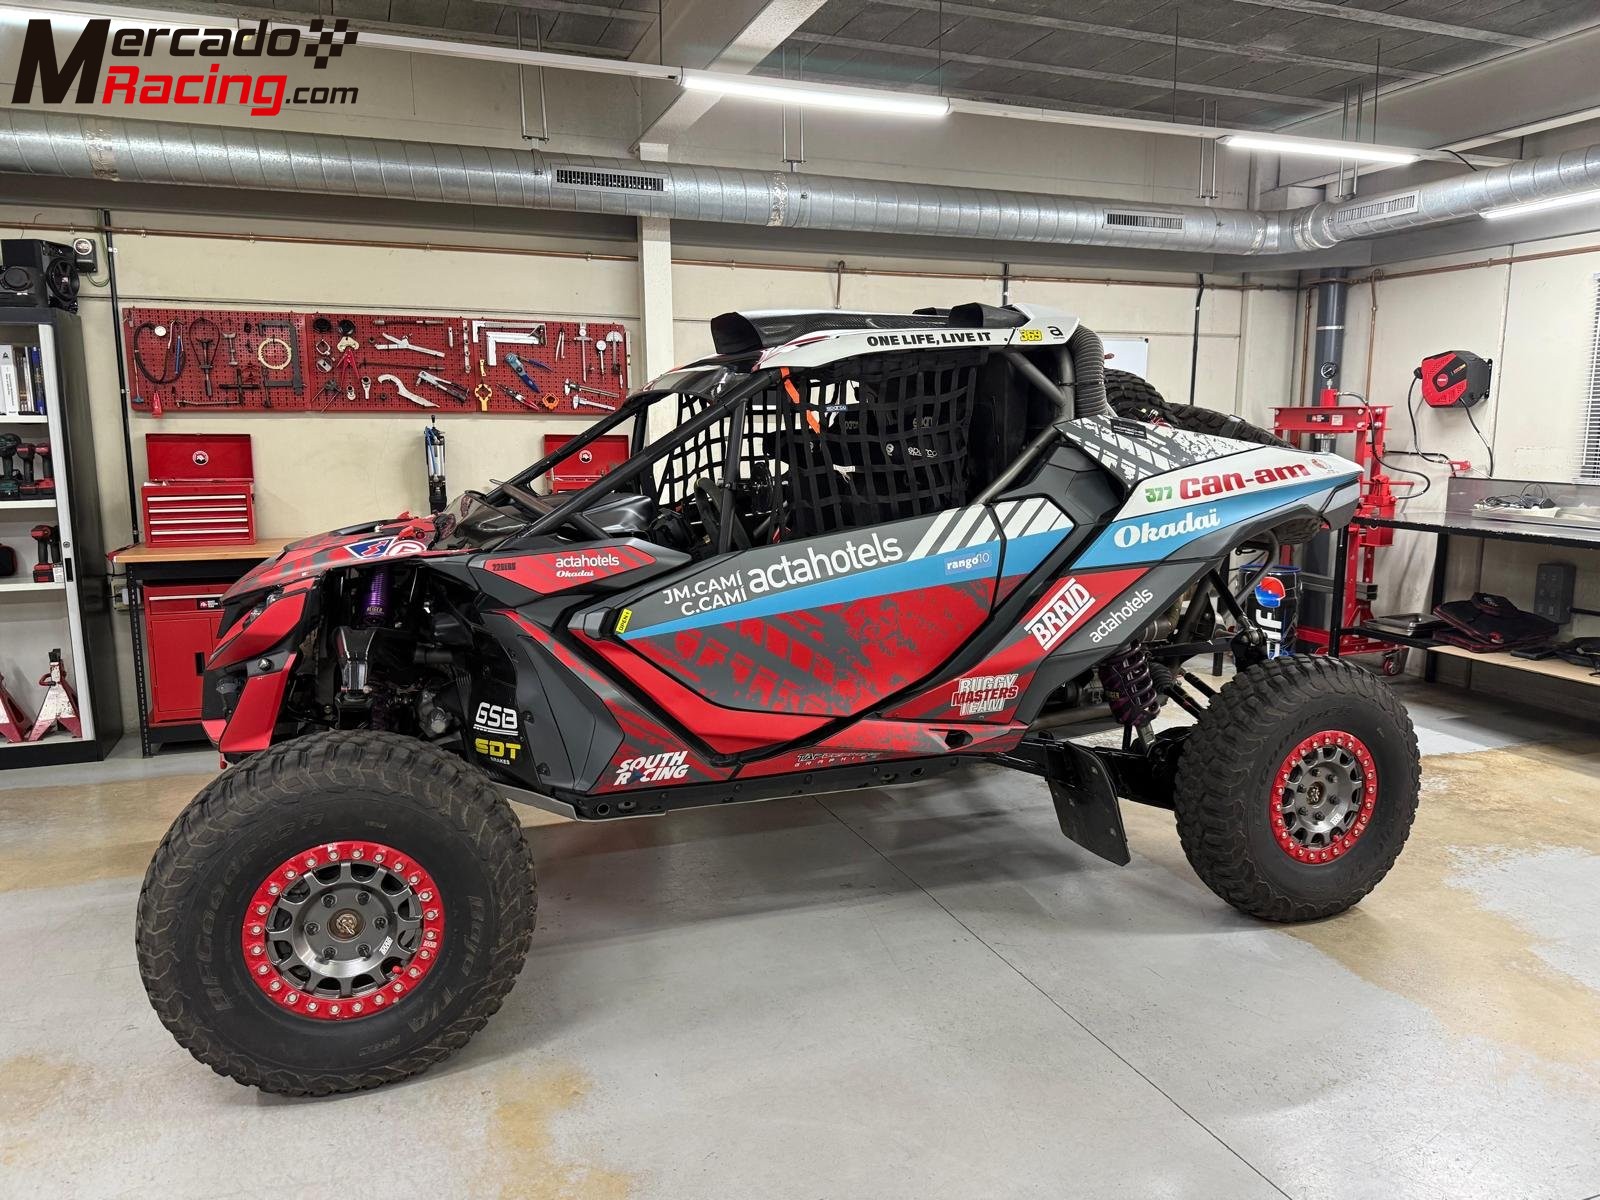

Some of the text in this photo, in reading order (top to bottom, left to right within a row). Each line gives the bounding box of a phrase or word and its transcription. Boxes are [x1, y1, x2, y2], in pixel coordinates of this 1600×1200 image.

[867, 332, 990, 347] ONE LIFE, LIVE IT
[1180, 463, 1311, 500] can-am
[1145, 486, 1173, 503] 377
[1113, 508, 1221, 549] Okadaï
[555, 554, 620, 568] actahotels
[748, 532, 903, 594] actahotels
[1029, 582, 1092, 649] BRAID
[1089, 588, 1154, 643] actahotels
[959, 675, 1018, 692] BUGGY
[952, 686, 1018, 706] MASTERS
[960, 699, 1005, 716] TEAM
[616, 751, 689, 774] SOUTH
